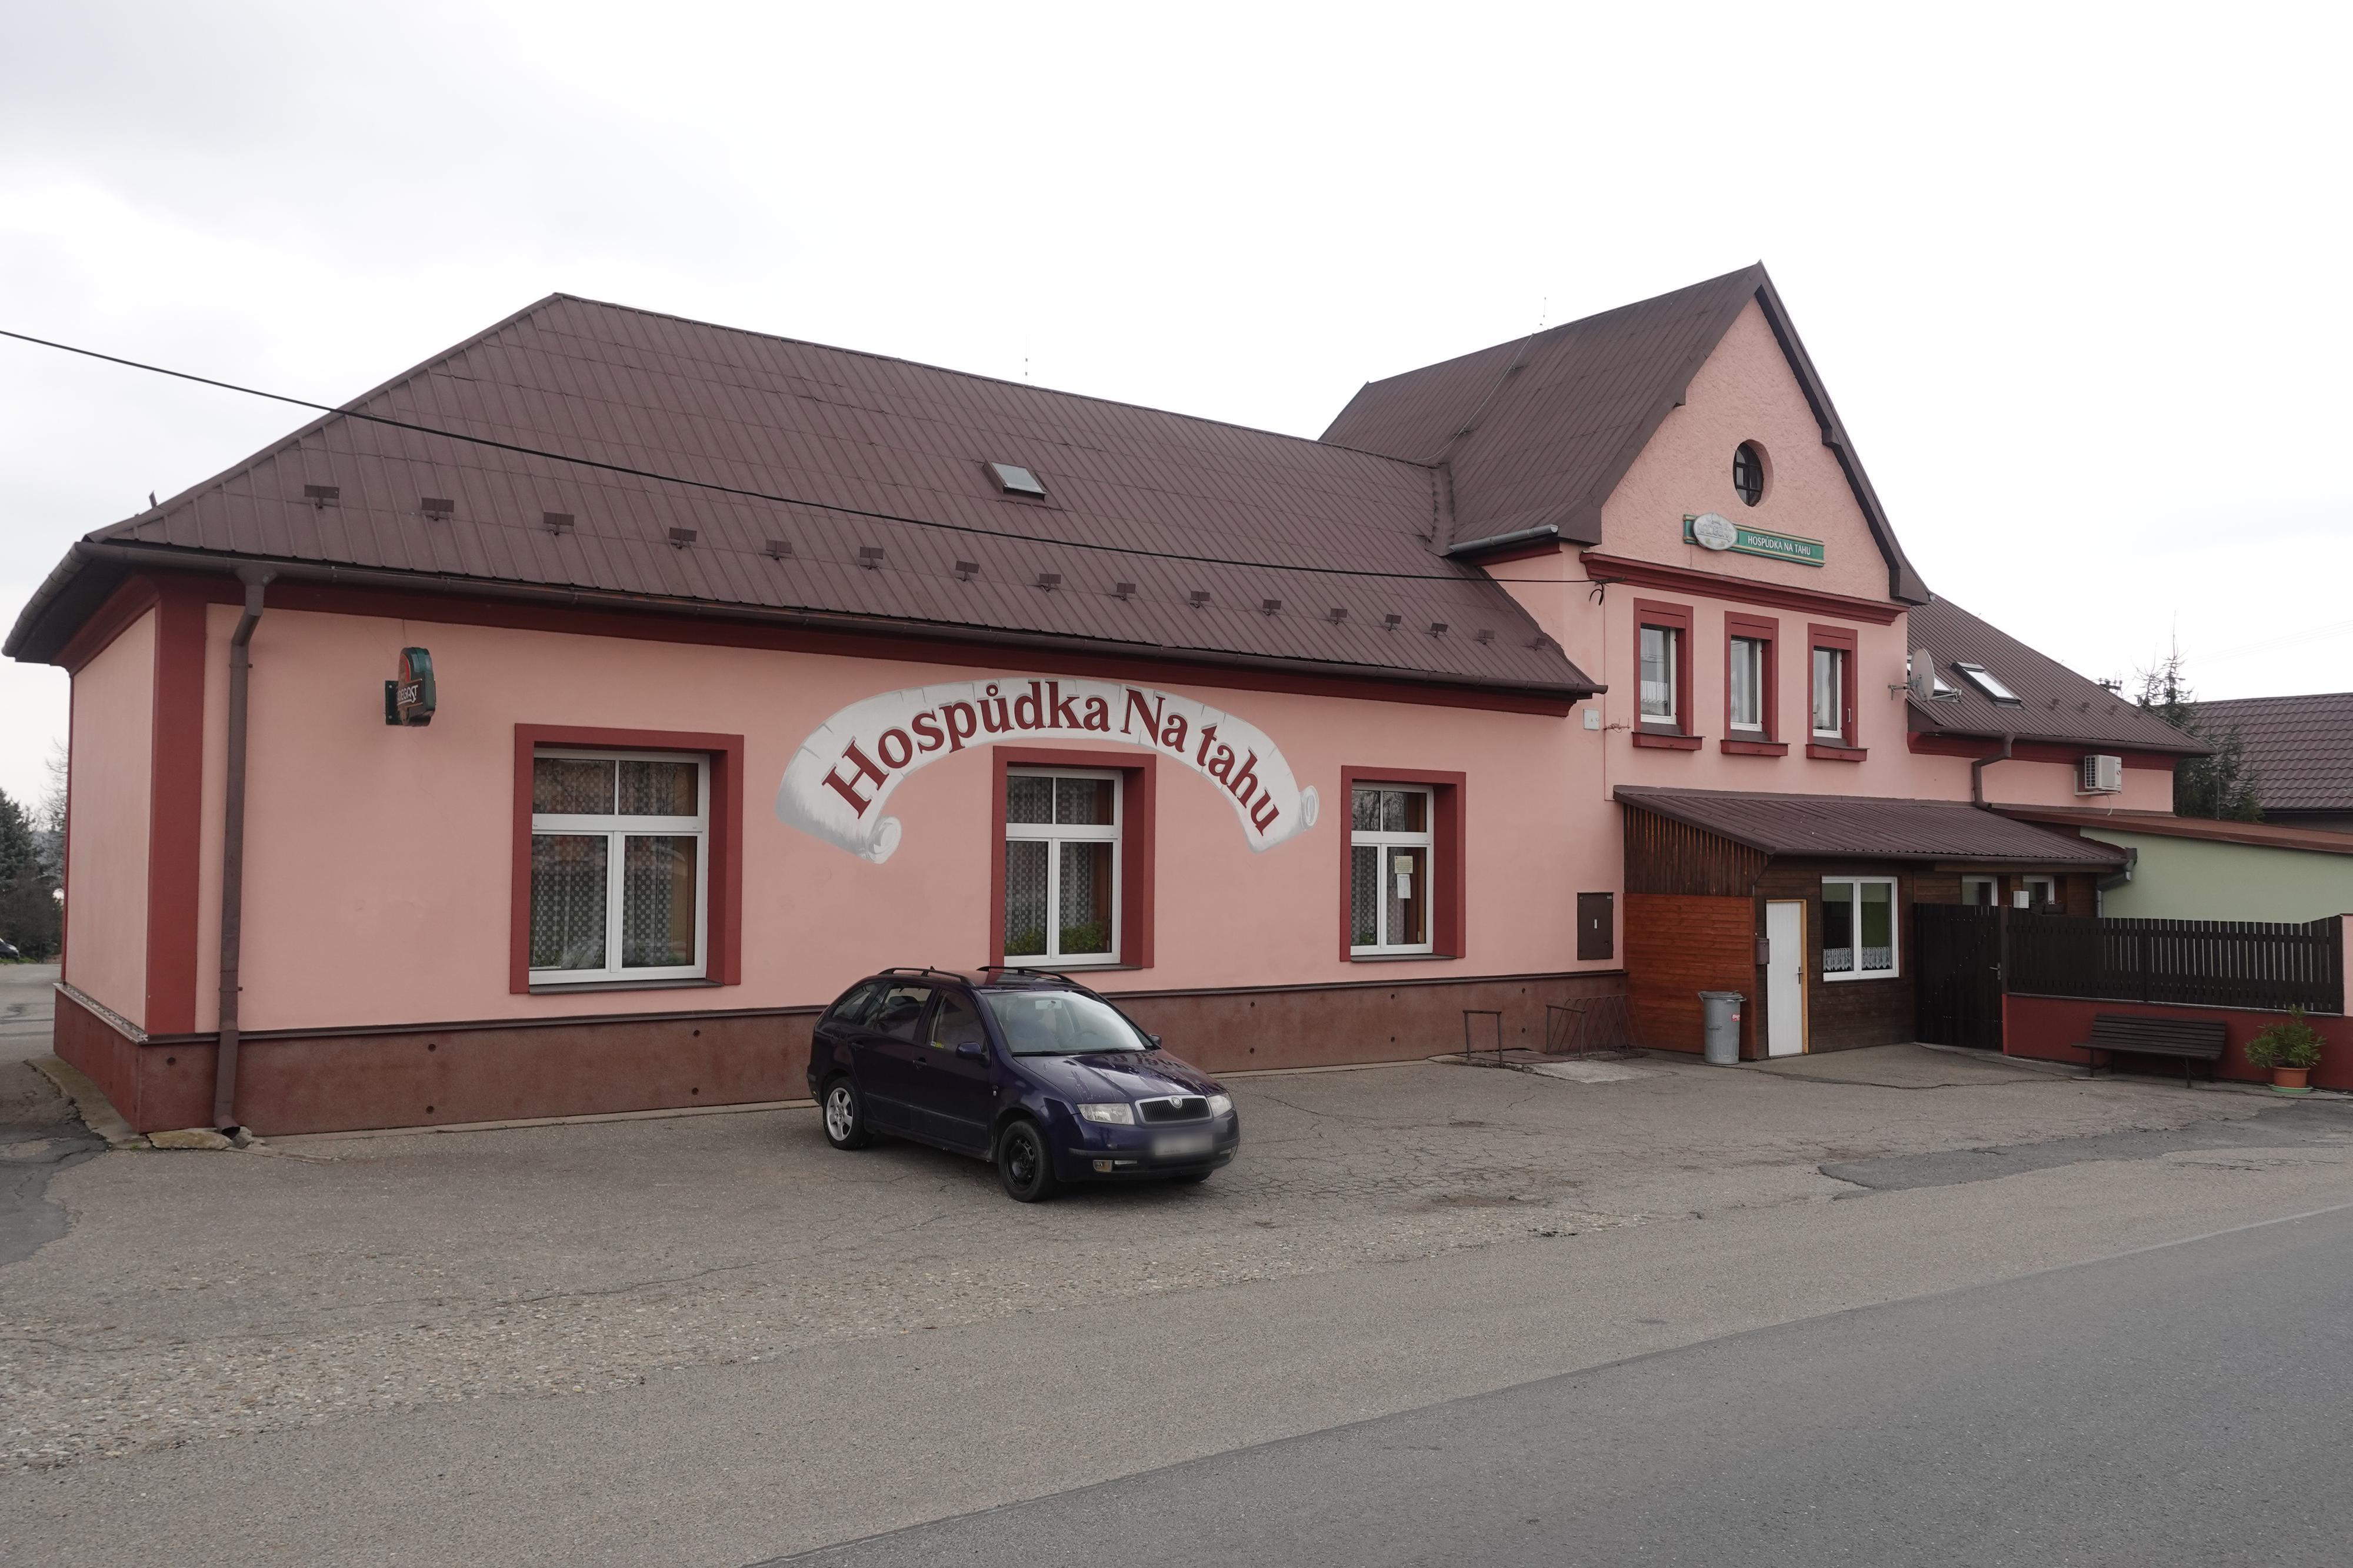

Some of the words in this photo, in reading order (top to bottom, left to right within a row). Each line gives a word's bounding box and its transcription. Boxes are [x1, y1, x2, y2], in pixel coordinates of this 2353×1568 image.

[1784, 542, 1794, 552] NA
[1794, 543, 1811, 555] TAHU
[822, 680, 1111, 819] Hospůdka
[1121, 687, 1188, 753] Na
[1197, 725, 1281, 836] tahu
